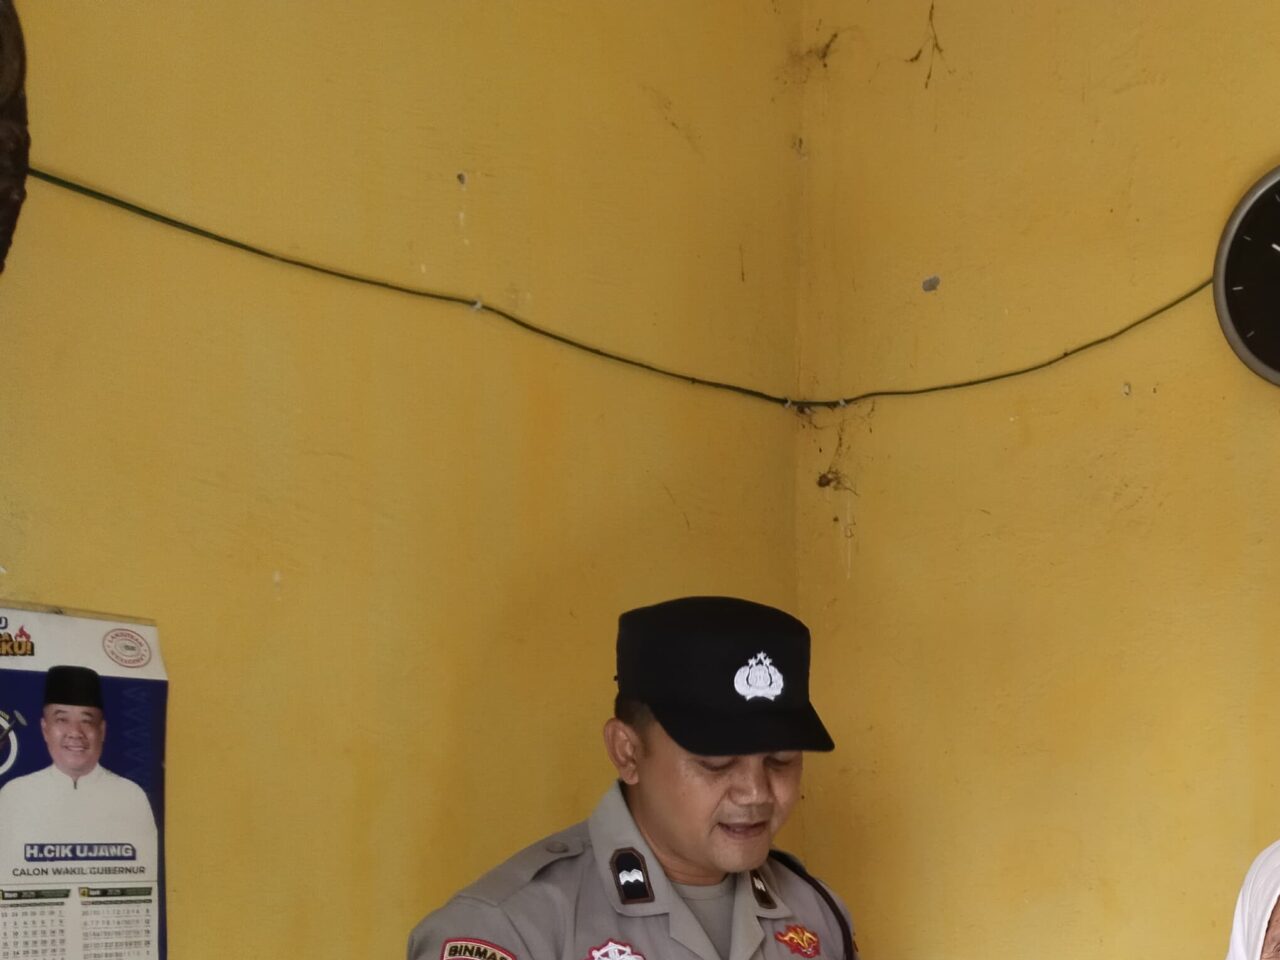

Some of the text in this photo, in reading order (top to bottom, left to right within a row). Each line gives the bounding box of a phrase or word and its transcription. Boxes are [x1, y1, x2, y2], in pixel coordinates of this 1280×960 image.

[25, 844, 133, 858] H.CIK UJANG
[12, 866, 146, 877] CALON WAKIL GUBERNUR
